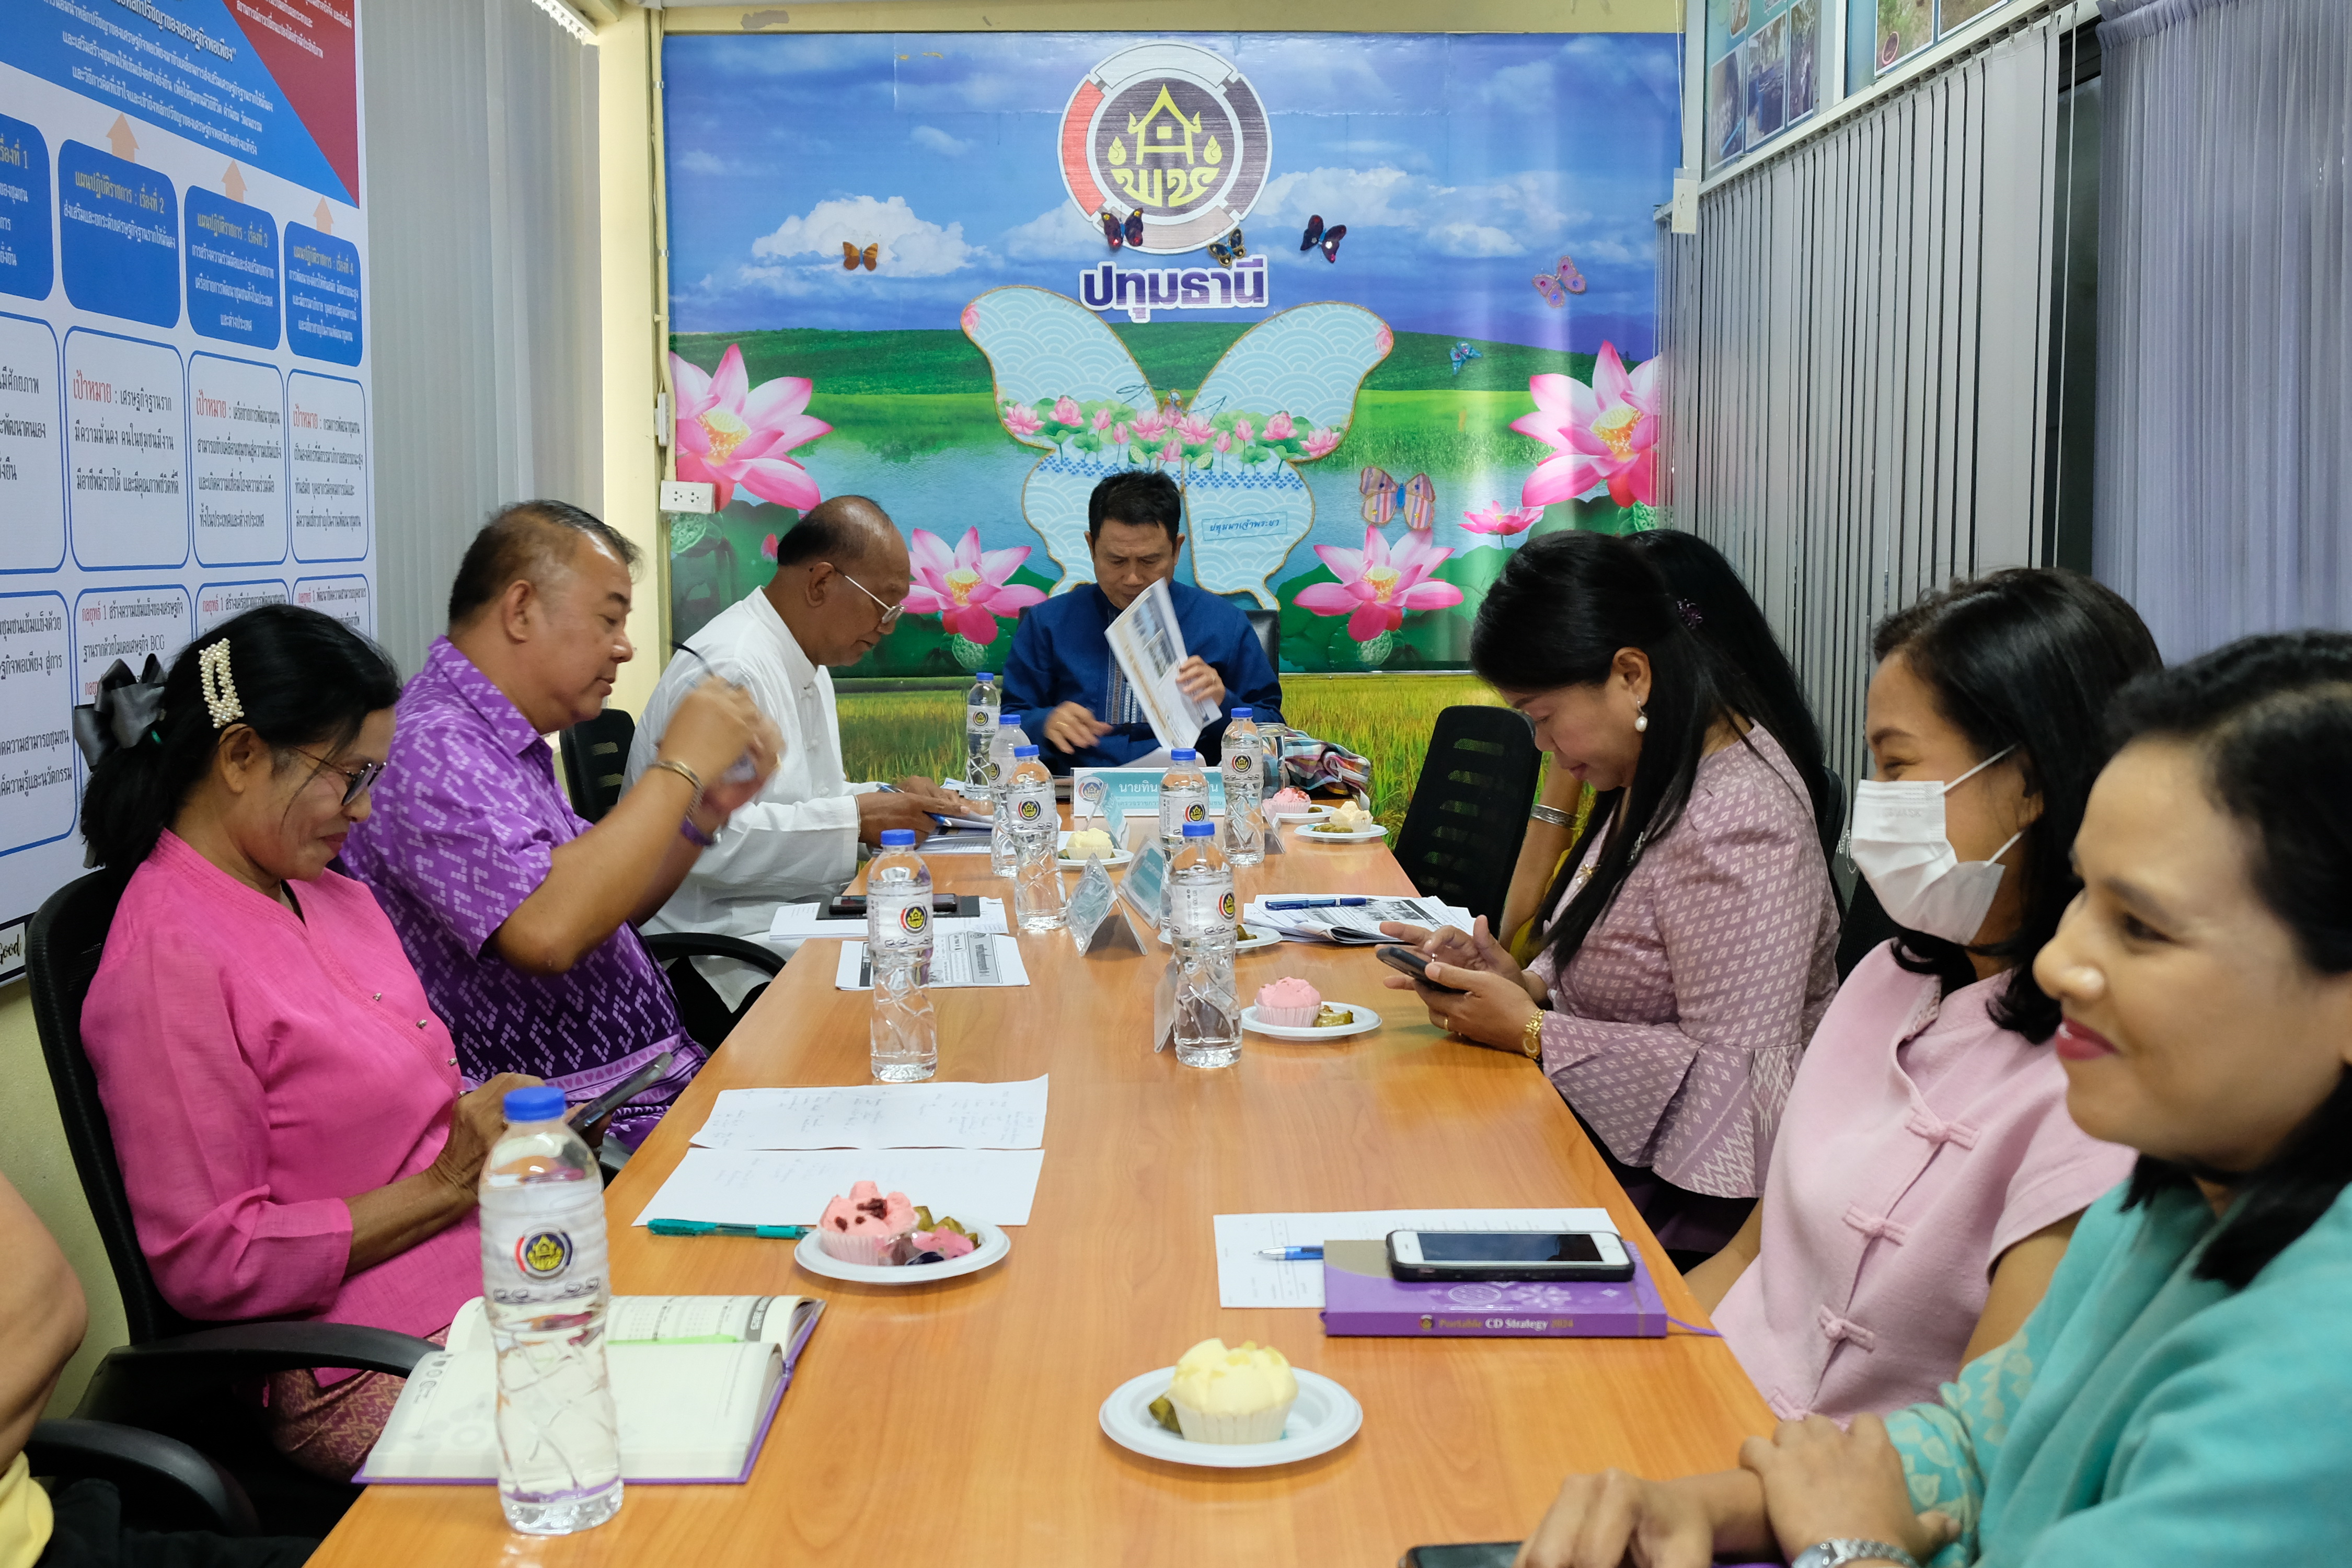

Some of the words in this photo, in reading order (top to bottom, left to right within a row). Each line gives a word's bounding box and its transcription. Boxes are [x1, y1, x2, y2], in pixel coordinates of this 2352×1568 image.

[23, 150, 28, 169] 1
[159, 198, 165, 214] 2
[264, 234, 268, 248] 3
[350, 263, 354, 275] 4
[1082, 257, 1265, 320] ปทุมธานี
[0, 366, 39, 394] มีศักยภาพ
[73, 369, 112, 403] เป้าหมาย
[120, 387, 172, 413] เศรษฐกิจฐานราก
[197, 389, 226, 419] เป้าหมาย
[293, 403, 318, 429] เป้าหมาย
[75, 417, 118, 445] มีความมั่นคง
[121, 422, 174, 454] คนในชุมชนมีงาน
[0, 451, 17, 480] งยืน
[77, 467, 121, 491] มีอาชีพมีรายได้
[82, 601, 101, 627] กลยุทธ์
[150, 635, 165, 651] BCG
[0, 650, 43, 680] ฐกิจพอเพียง
[46, 650, 62, 676] สู่การ
[0, 729, 69, 756] ดความสามารถชุมชน
[0, 766, 72, 797] ค์ความรู้และนวัตกรรม
[1119, 780, 1159, 793] นายทิน
[1485, 1318, 1504, 1329] CD
[1505, 1317, 1549, 1332] Strategy
